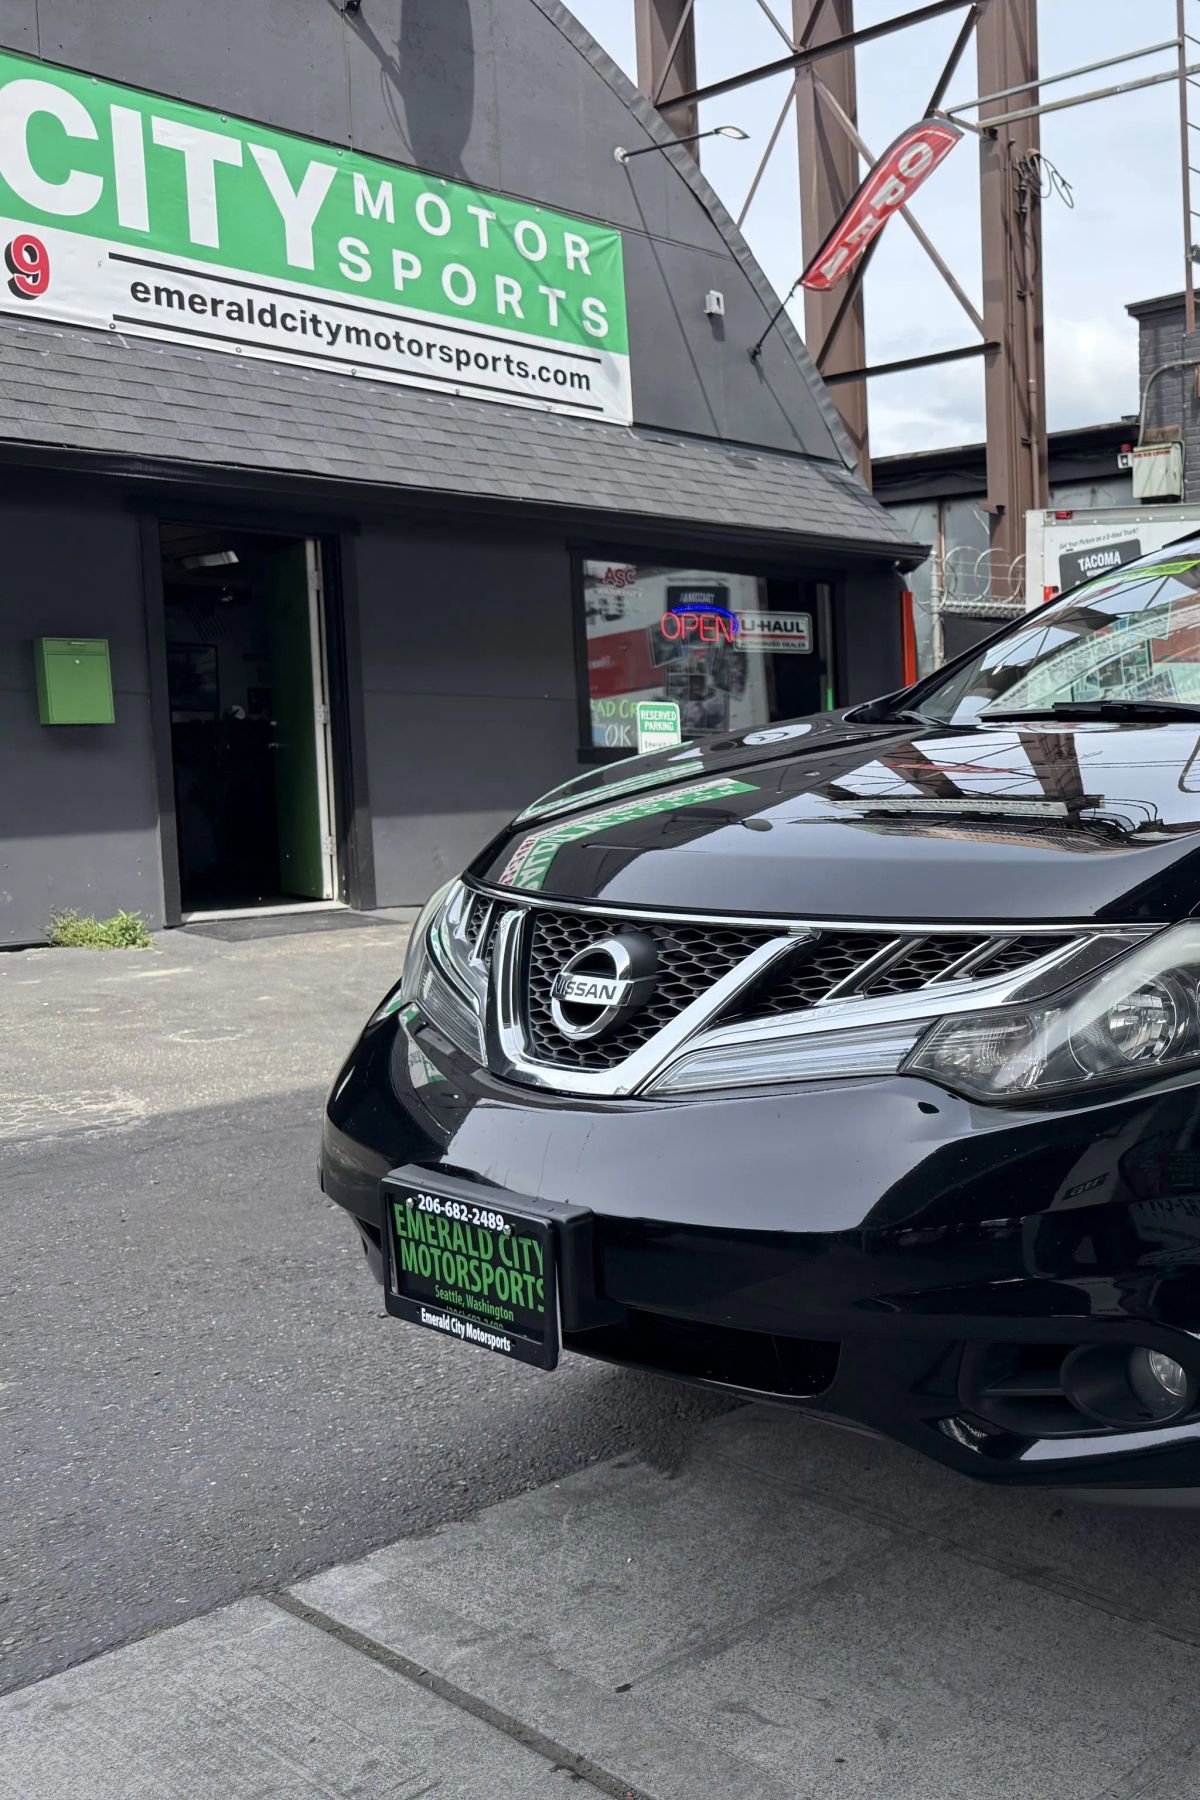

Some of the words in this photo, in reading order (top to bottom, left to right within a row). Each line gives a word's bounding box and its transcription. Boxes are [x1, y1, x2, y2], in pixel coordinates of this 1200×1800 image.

[0, 78, 338, 271] CITY
[353, 172, 592, 276] MOTOR
[337, 236, 610, 339] SPORTS
[130, 276, 591, 392] emeraldcitymotorsports.com
[602, 567, 636, 589] ASC
[1077, 550, 1122, 572] TACOMA
[660, 611, 736, 645] OPEN
[740, 618, 804, 634] U-HAUL
[782, 641, 807, 649] DEALER
[640, 710, 677, 721] RESERVED
[644, 720, 674, 731] PARKING
[605, 723, 632, 747] OK
[553, 974, 618, 1000] NISSAN
[417, 1193, 505, 1231] 206-682-2489
[393, 1202, 494, 1261] EMERALD
[498, 1233, 544, 1276] CITY
[400, 1238, 545, 1313] MOTORSPORTS
[435, 1284, 465, 1308] Seattle,
[466, 1293, 515, 1322] Washington
[421, 1307, 450, 1331] Emerald
[450, 1317, 466, 1340] City
[466, 1322, 511, 1352] Motorsports
